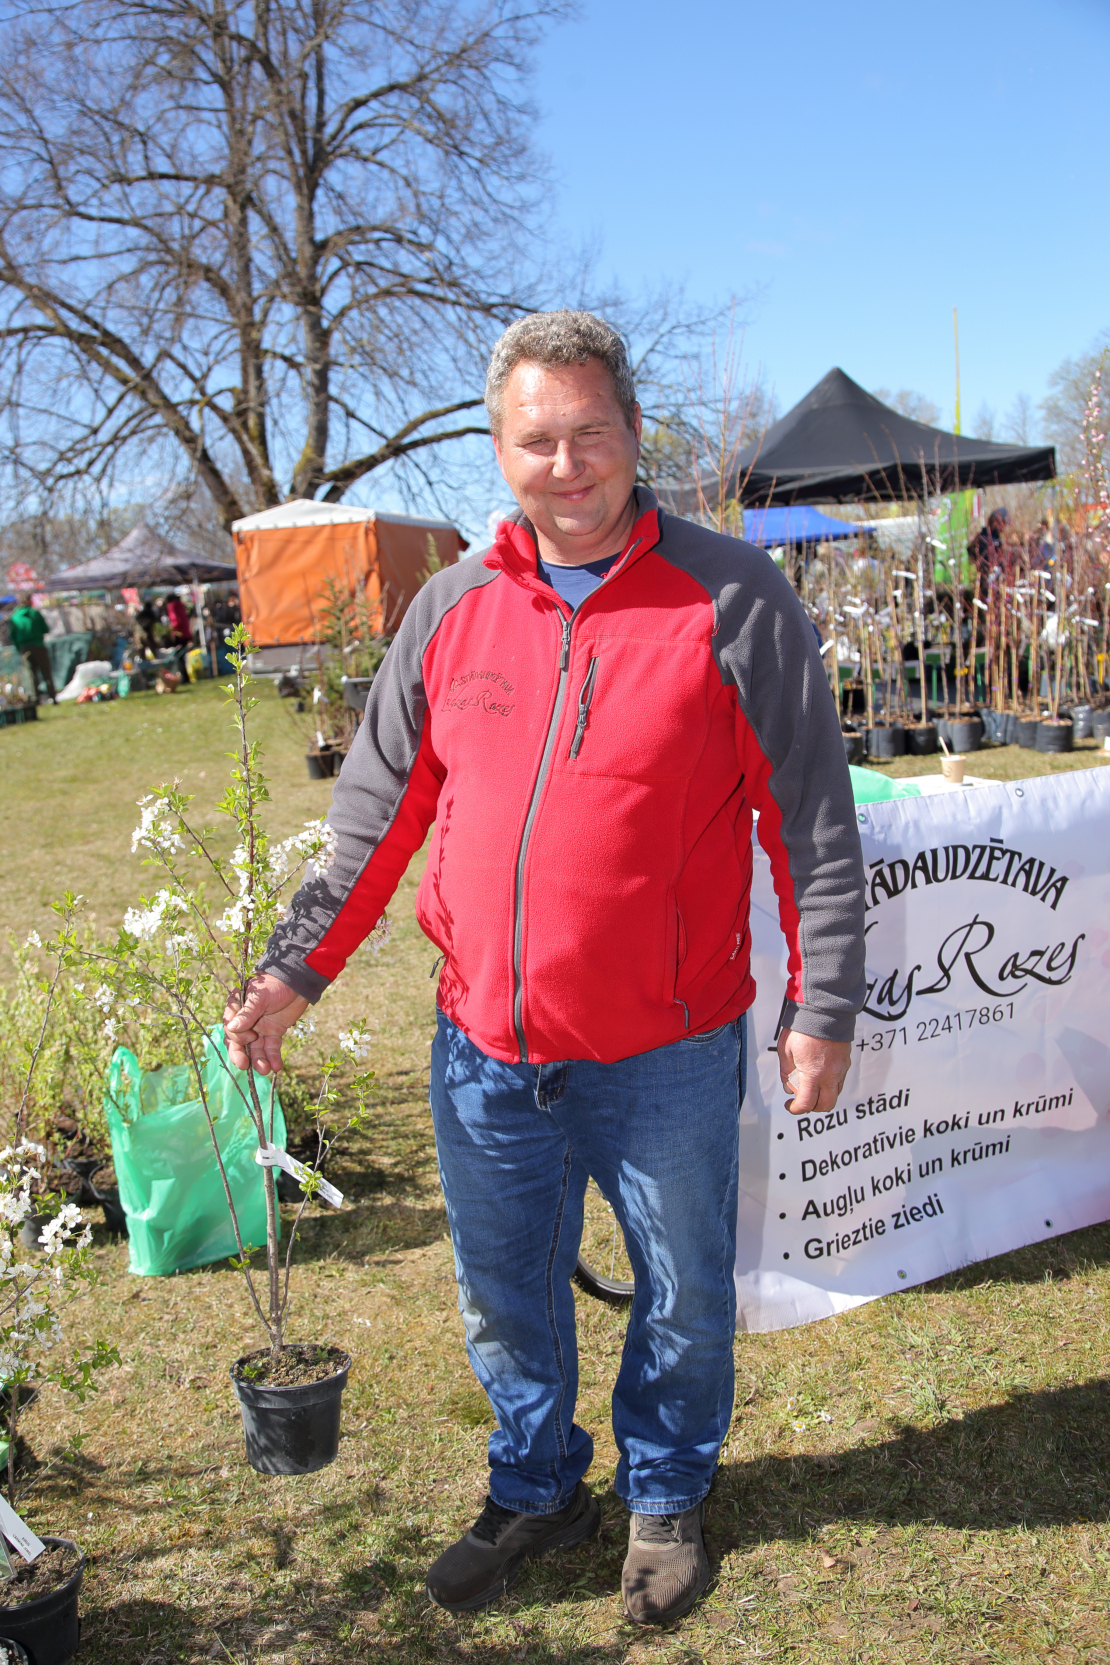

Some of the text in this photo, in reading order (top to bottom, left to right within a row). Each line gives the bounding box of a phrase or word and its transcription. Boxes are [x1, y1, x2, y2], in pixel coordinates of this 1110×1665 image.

[865, 837, 1070, 911] ĀDAUDZĒTAVA
[856, 1002, 1015, 1052] +371 22417861
[801, 1087, 1074, 1182] Dekoratīvie koki un krūmi
[855, 1088, 911, 1120] stādi
[801, 1134, 1011, 1221] Augļu koki un krūmi
[803, 1192, 945, 1260] Grieztie ziedi
